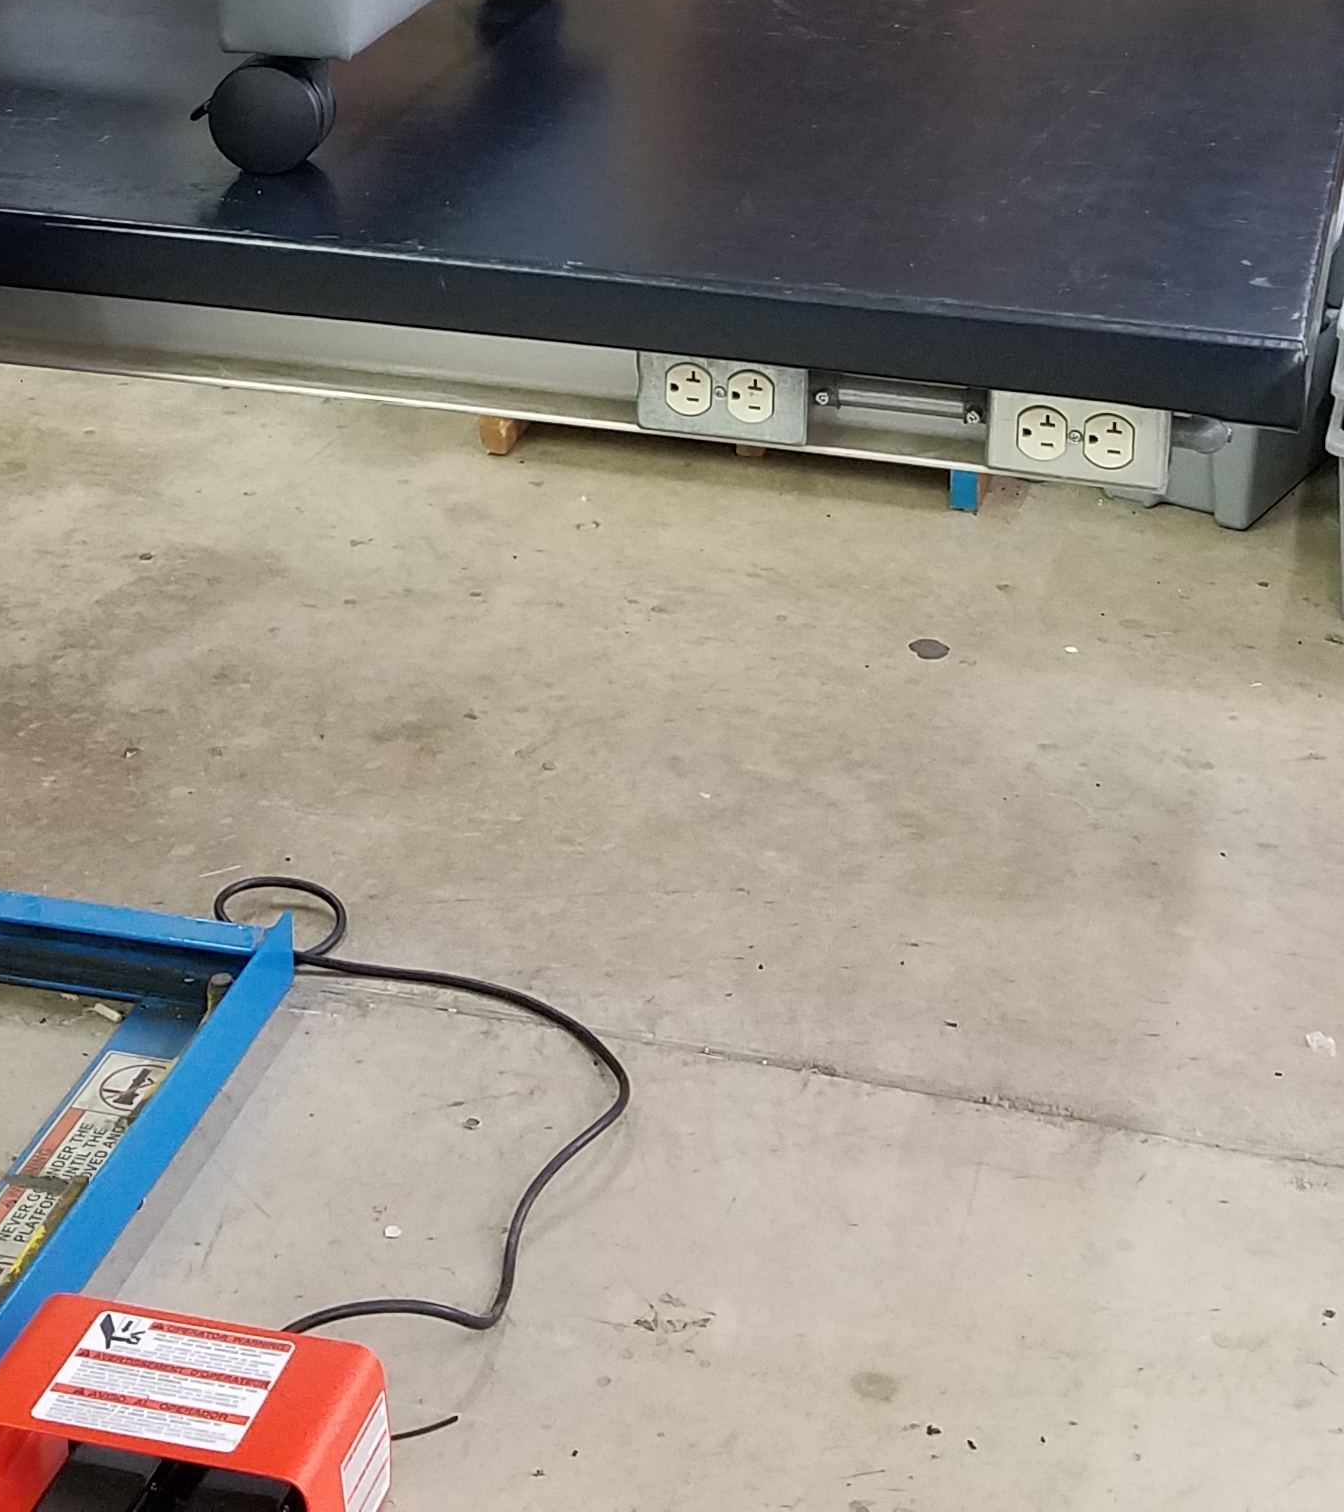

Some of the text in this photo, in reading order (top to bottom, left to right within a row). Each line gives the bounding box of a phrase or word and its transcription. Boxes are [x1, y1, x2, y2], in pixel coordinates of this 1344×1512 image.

[46, 1146, 78, 1181] NDER
[70, 1122, 94, 1152] THE
[12, 1192, 60, 1244] PLATFOR
[84, 1128, 107, 1158] THE
[232, 1334, 286, 1352] WARNING
[87, 1389, 127, 1403] AVISO
[158, 1402, 229, 1421] OPERADOR
